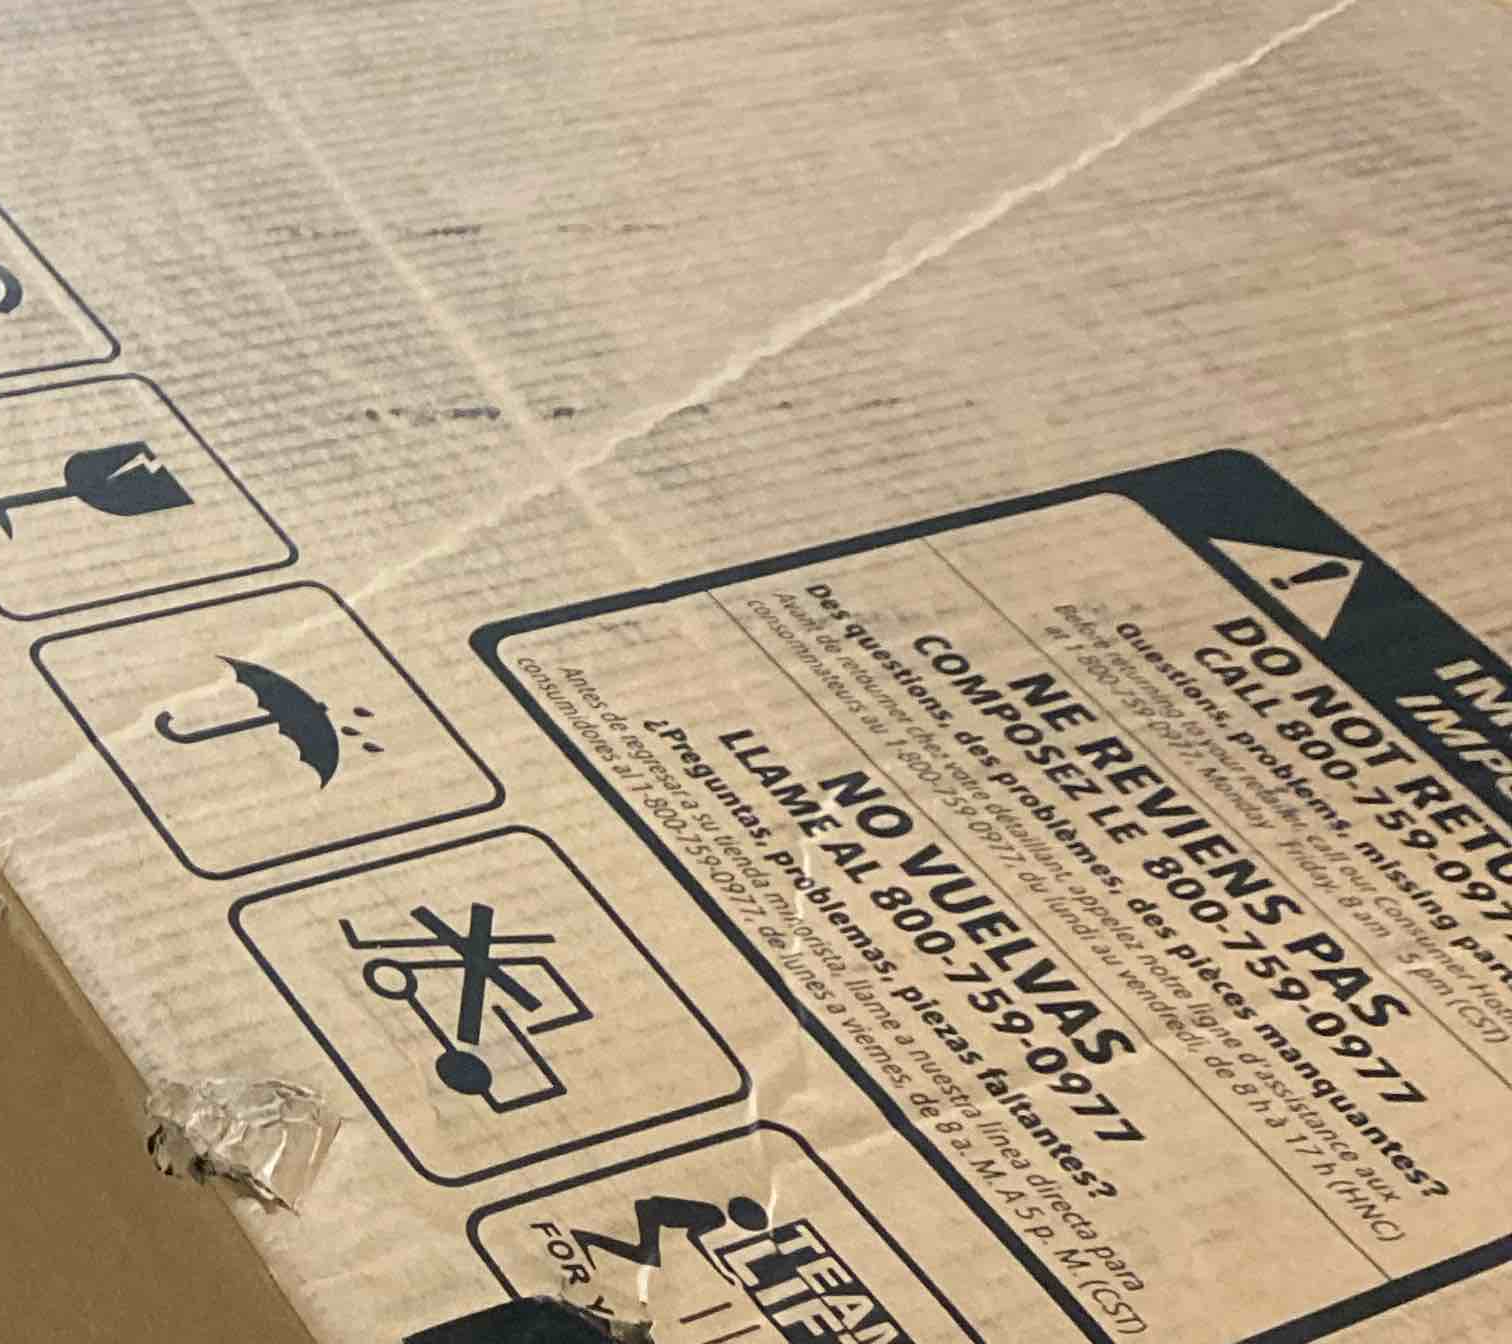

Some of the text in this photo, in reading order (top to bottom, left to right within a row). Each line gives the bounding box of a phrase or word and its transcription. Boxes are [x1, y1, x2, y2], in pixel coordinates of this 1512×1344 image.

[771, 592, 828, 634] Avant
[835, 655, 915, 724] retourner
[904, 725, 951, 760] chez
[943, 761, 992, 801] votre
[982, 802, 1074, 884] détaillant,
[1067, 885, 1145, 951] appelez
[1135, 954, 1194, 1000] notre
[1186, 1002, 1244, 1049] ligne
[1236, 1052, 1360, 1163] d'assistance
[1354, 1166, 1401, 1203] aux
[804, 583, 1451, 1198] Des questions, des problèmes, des pièces manquantes?
[913, 635, 1428, 1103] COMPOSEZ LE 800-759-0977
[1006, 672, 1412, 1028] NE REVIENS PAS
[1115, 622, 1231, 729] Questions,
[1225, 730, 1353, 839] problems,
[1353, 841, 1460, 932] missing
[1193, 646, 1512, 942] CALL 800-759-097
[1212, 616, 1303, 677] DO
[1290, 683, 1418, 768] NOT
[516, 657, 622, 763] consumidores
[778, 951, 837, 1002] lunes
[840, 1016, 913, 1090] viernes,
[1076, 1279, 1149, 1335] (CST)
[558, 667, 609, 710] Antes
[620, 734, 692, 797] regresar
[712, 834, 772, 889] tienda
[843, 978, 902, 1031] llame
[907, 1049, 983, 1120] nuestra
[976, 1120, 1032, 1171] línea
[1025, 1173, 1099, 1241] directa
[1083, 1245, 1145, 1292] para
[642, 719, 1118, 1199] ¿Preguntas, problemas, piezas faltantes?
[717, 728, 1146, 1142] LLAME AL 800-759-0977
[746, 599, 869, 714] consommateurs
[1042, 895, 1101, 941] lundi
[1116, 968, 1205, 1054] vendredi,
[1325, 1179, 1407, 1243] (HNC)
[817, 770, 1137, 1065] NO VUELVAS
[530, 1218, 593, 1289] FOR
